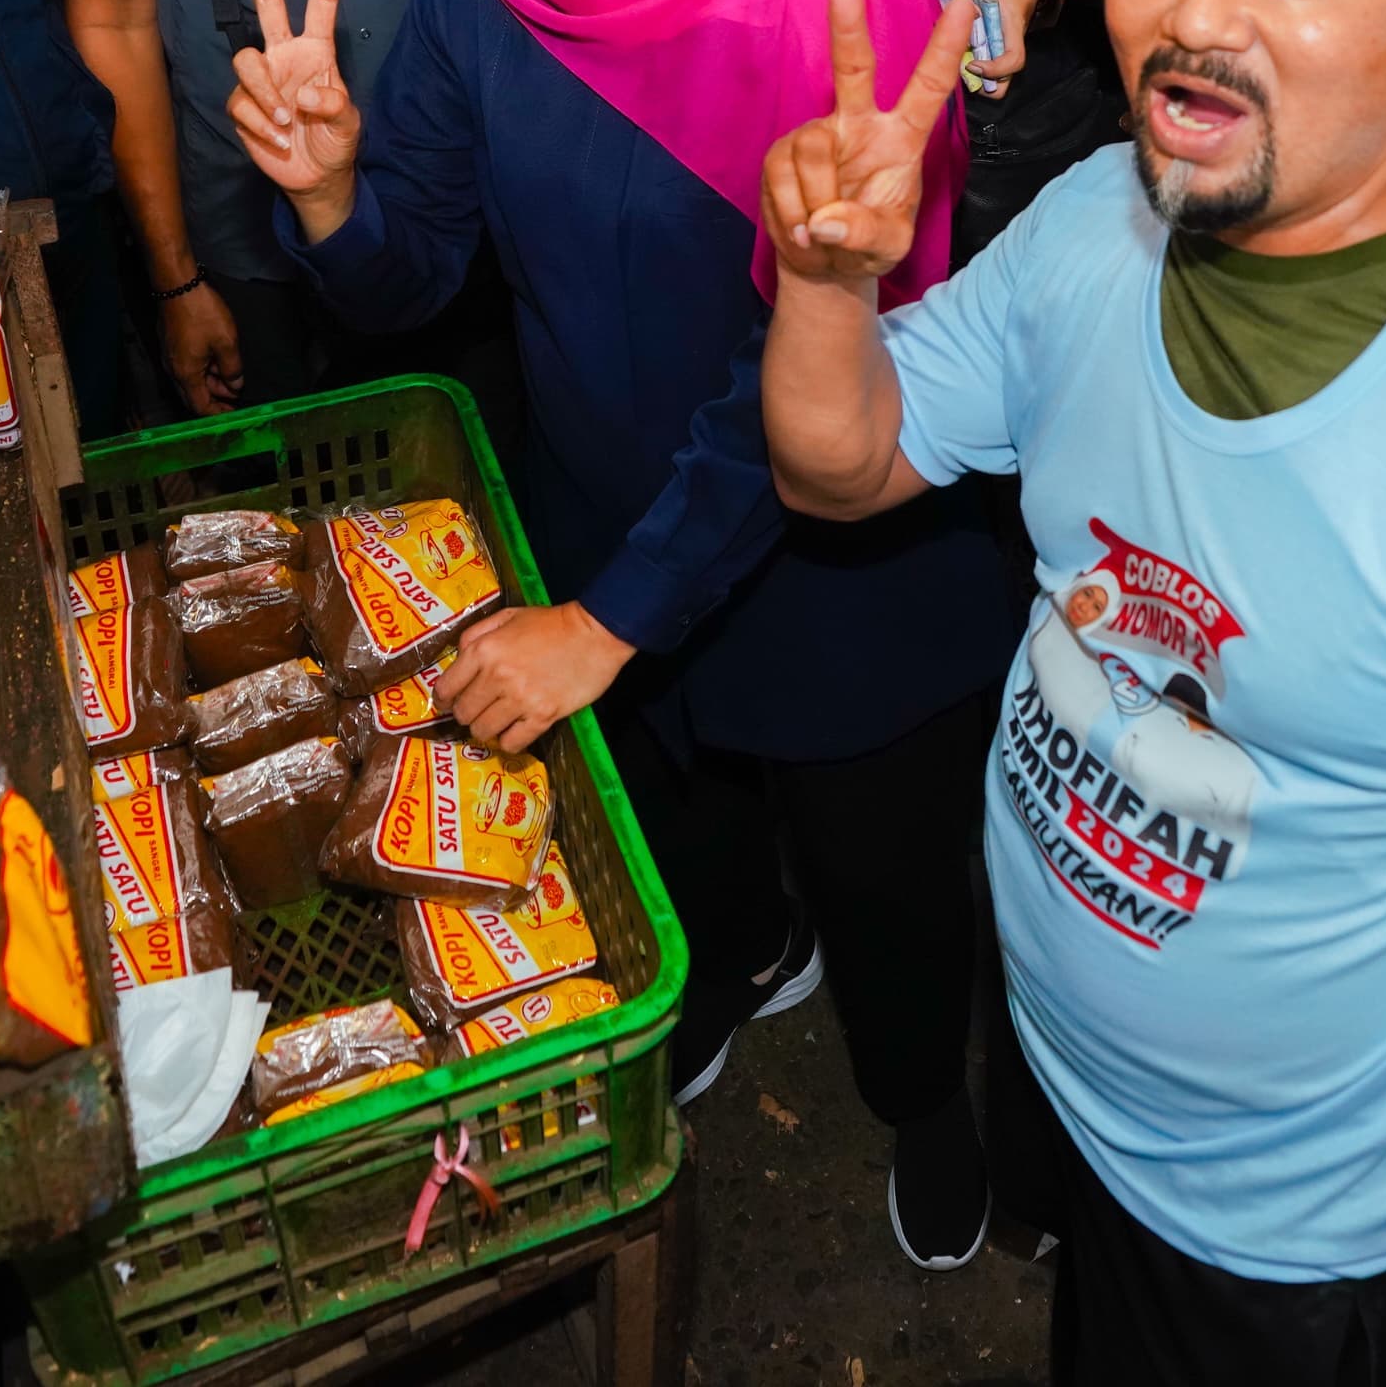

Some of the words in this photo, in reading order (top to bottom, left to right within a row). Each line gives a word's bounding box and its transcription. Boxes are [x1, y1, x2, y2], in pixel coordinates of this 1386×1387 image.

[366, 591, 403, 639] KOPI
[394, 572, 439, 613] SATU
[1124, 553, 1222, 628] COBLOS
[1108, 601, 1187, 657] NOMOR
[1192, 631, 1207, 676] 2
[385, 686, 408, 717] KO
[434, 740, 454, 789] SATU
[1015, 678, 1234, 882] KHOFIFAH
[390, 795, 421, 855] KOPI
[438, 796, 459, 852] SATU
[1010, 716, 1062, 813] EMIL
[1078, 809, 1188, 899] 2024
[130, 790, 156, 837] KOPI
[148, 840, 161, 882] SANGRAI
[109, 862, 150, 915] SATU
[147, 918, 174, 972] KOPI
[443, 932, 478, 986] KOPI
[476, 914, 526, 965] SATU
[109, 941, 134, 993] ATU
[527, 997, 547, 1018] 11
